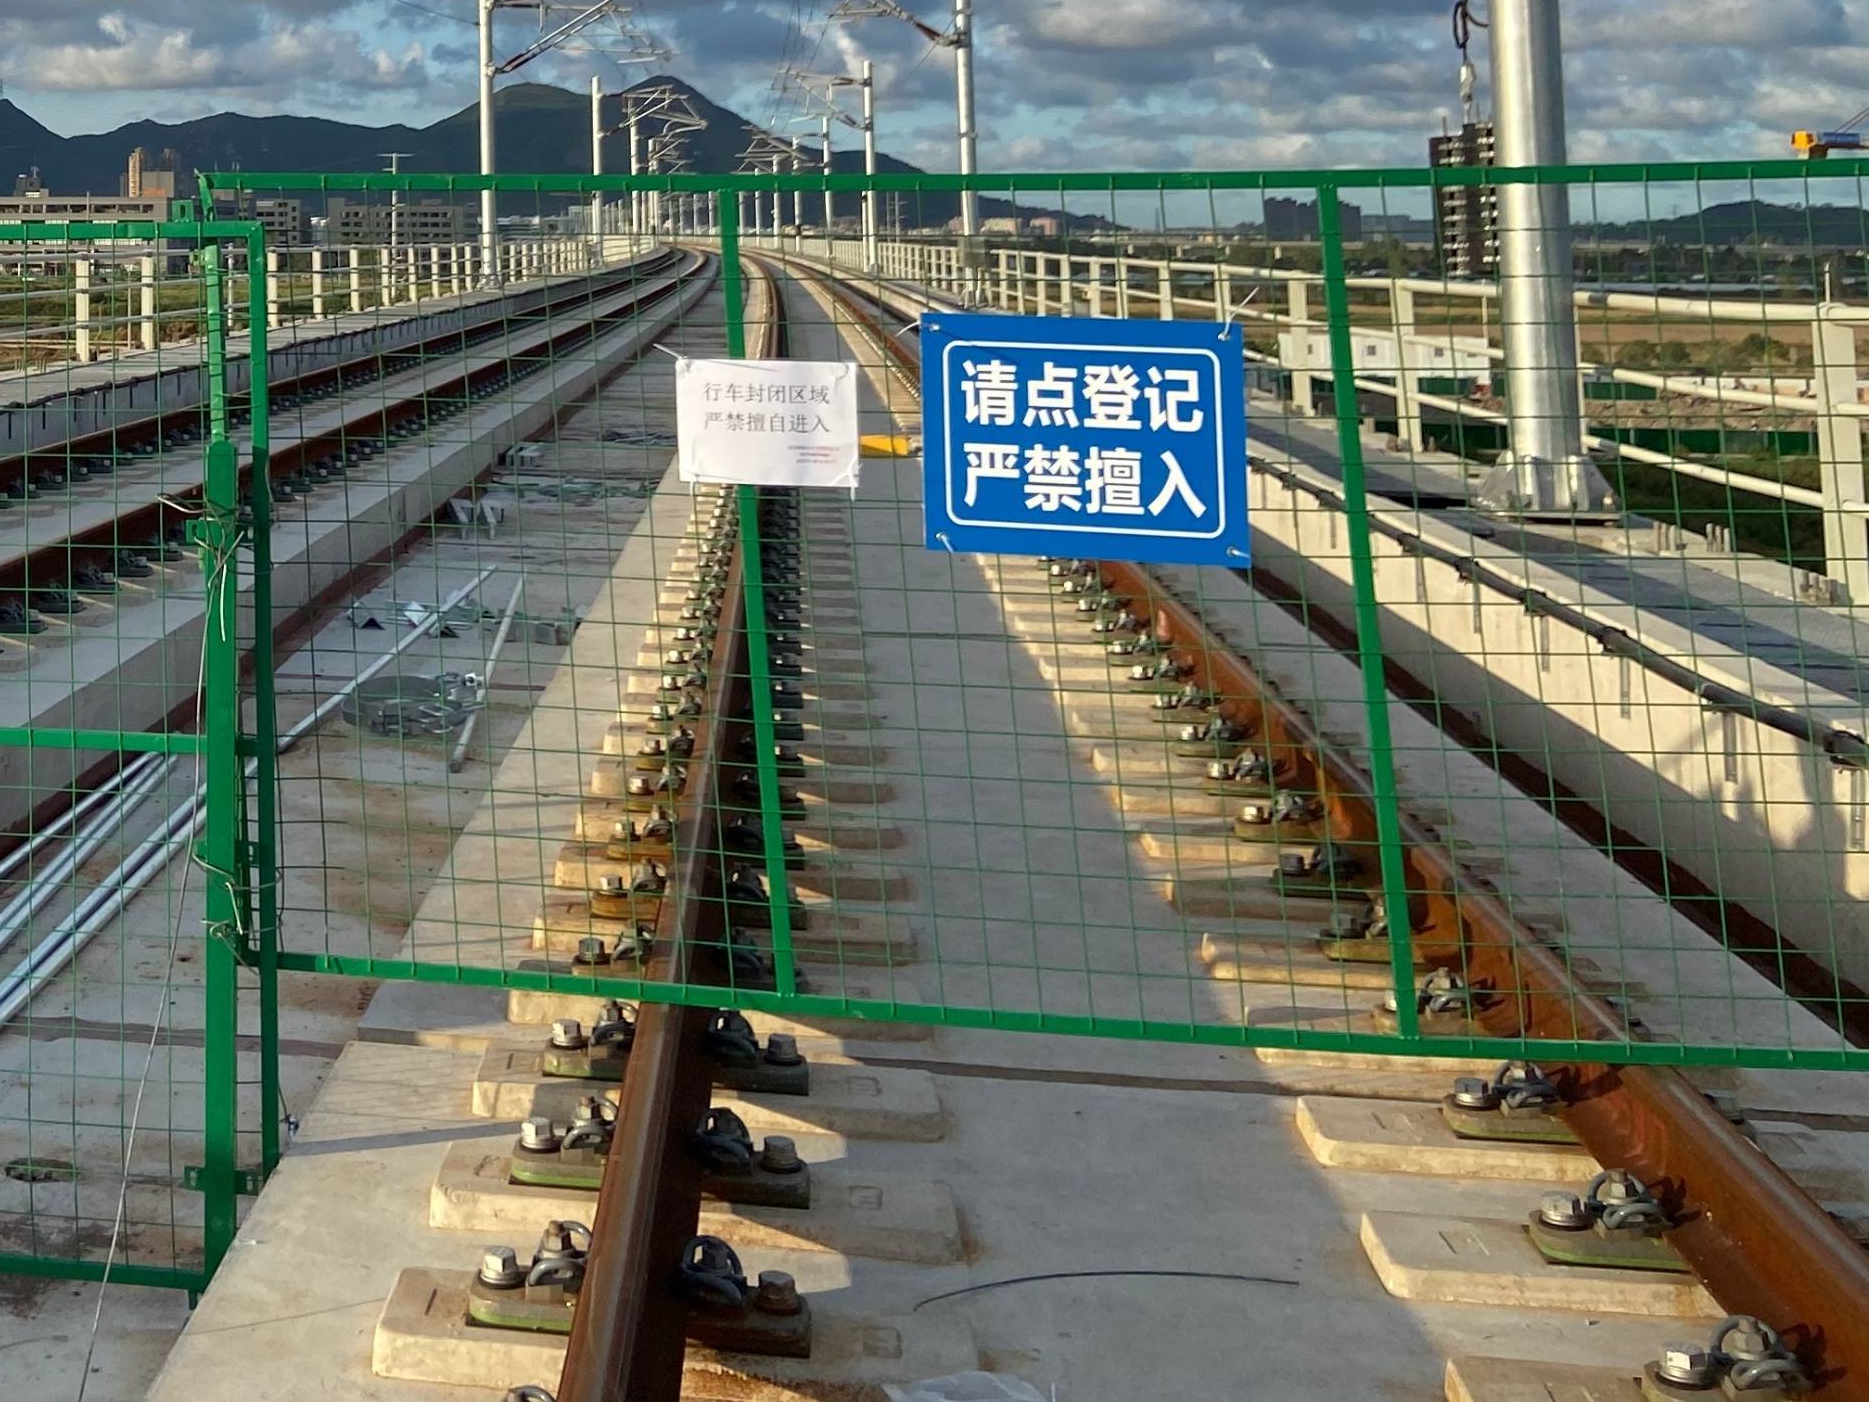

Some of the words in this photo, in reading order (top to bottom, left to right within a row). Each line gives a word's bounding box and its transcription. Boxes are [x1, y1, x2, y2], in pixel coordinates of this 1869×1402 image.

[704, 382, 830, 405] 行车封闭区域
[961, 359, 1204, 433] 请点登记
[704, 411, 830, 434] 严禁擅自进入
[964, 442, 1207, 519] 严禁擅入
